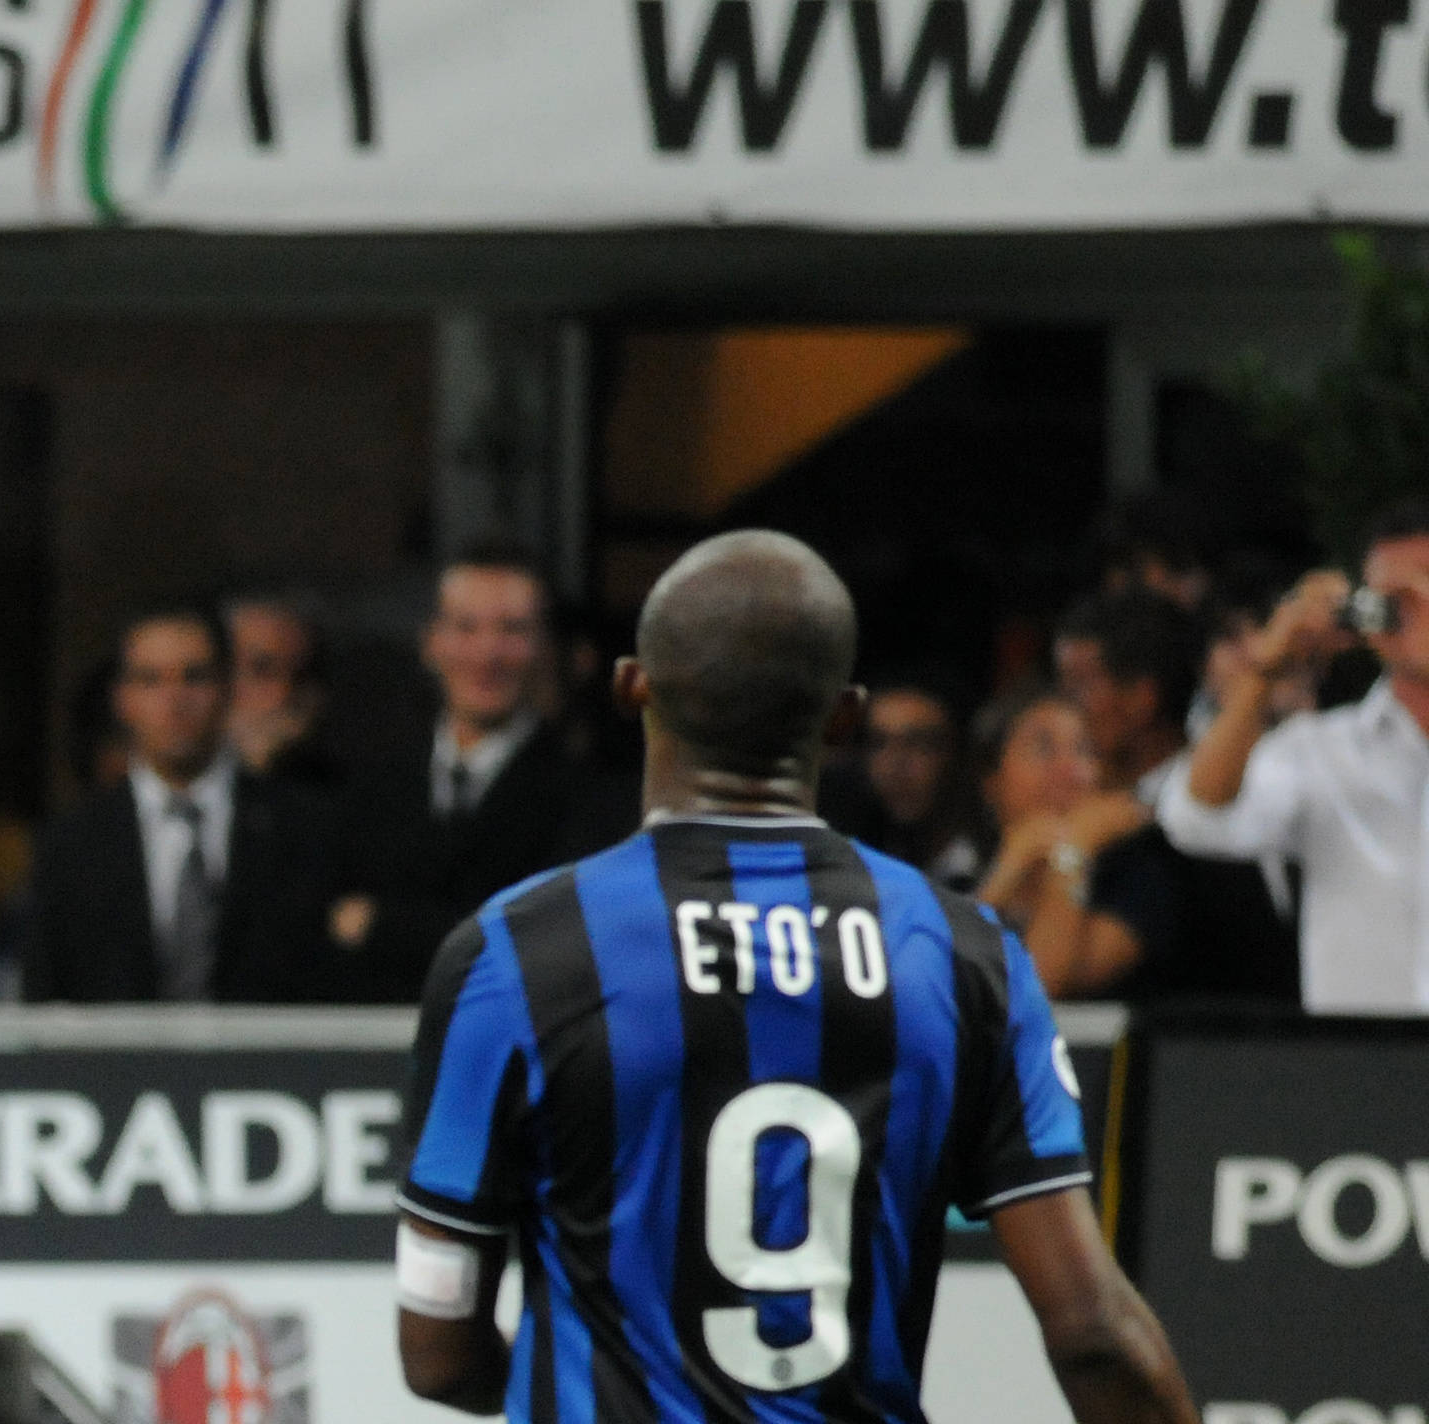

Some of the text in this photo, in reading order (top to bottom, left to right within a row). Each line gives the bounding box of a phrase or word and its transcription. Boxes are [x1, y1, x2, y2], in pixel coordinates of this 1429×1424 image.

[631, 0, 1429, 153] www.t
[676, 900, 889, 999] ETO'O
[701, 1081, 863, 1391] 9
[1211, 1152, 1429, 1269] PO
